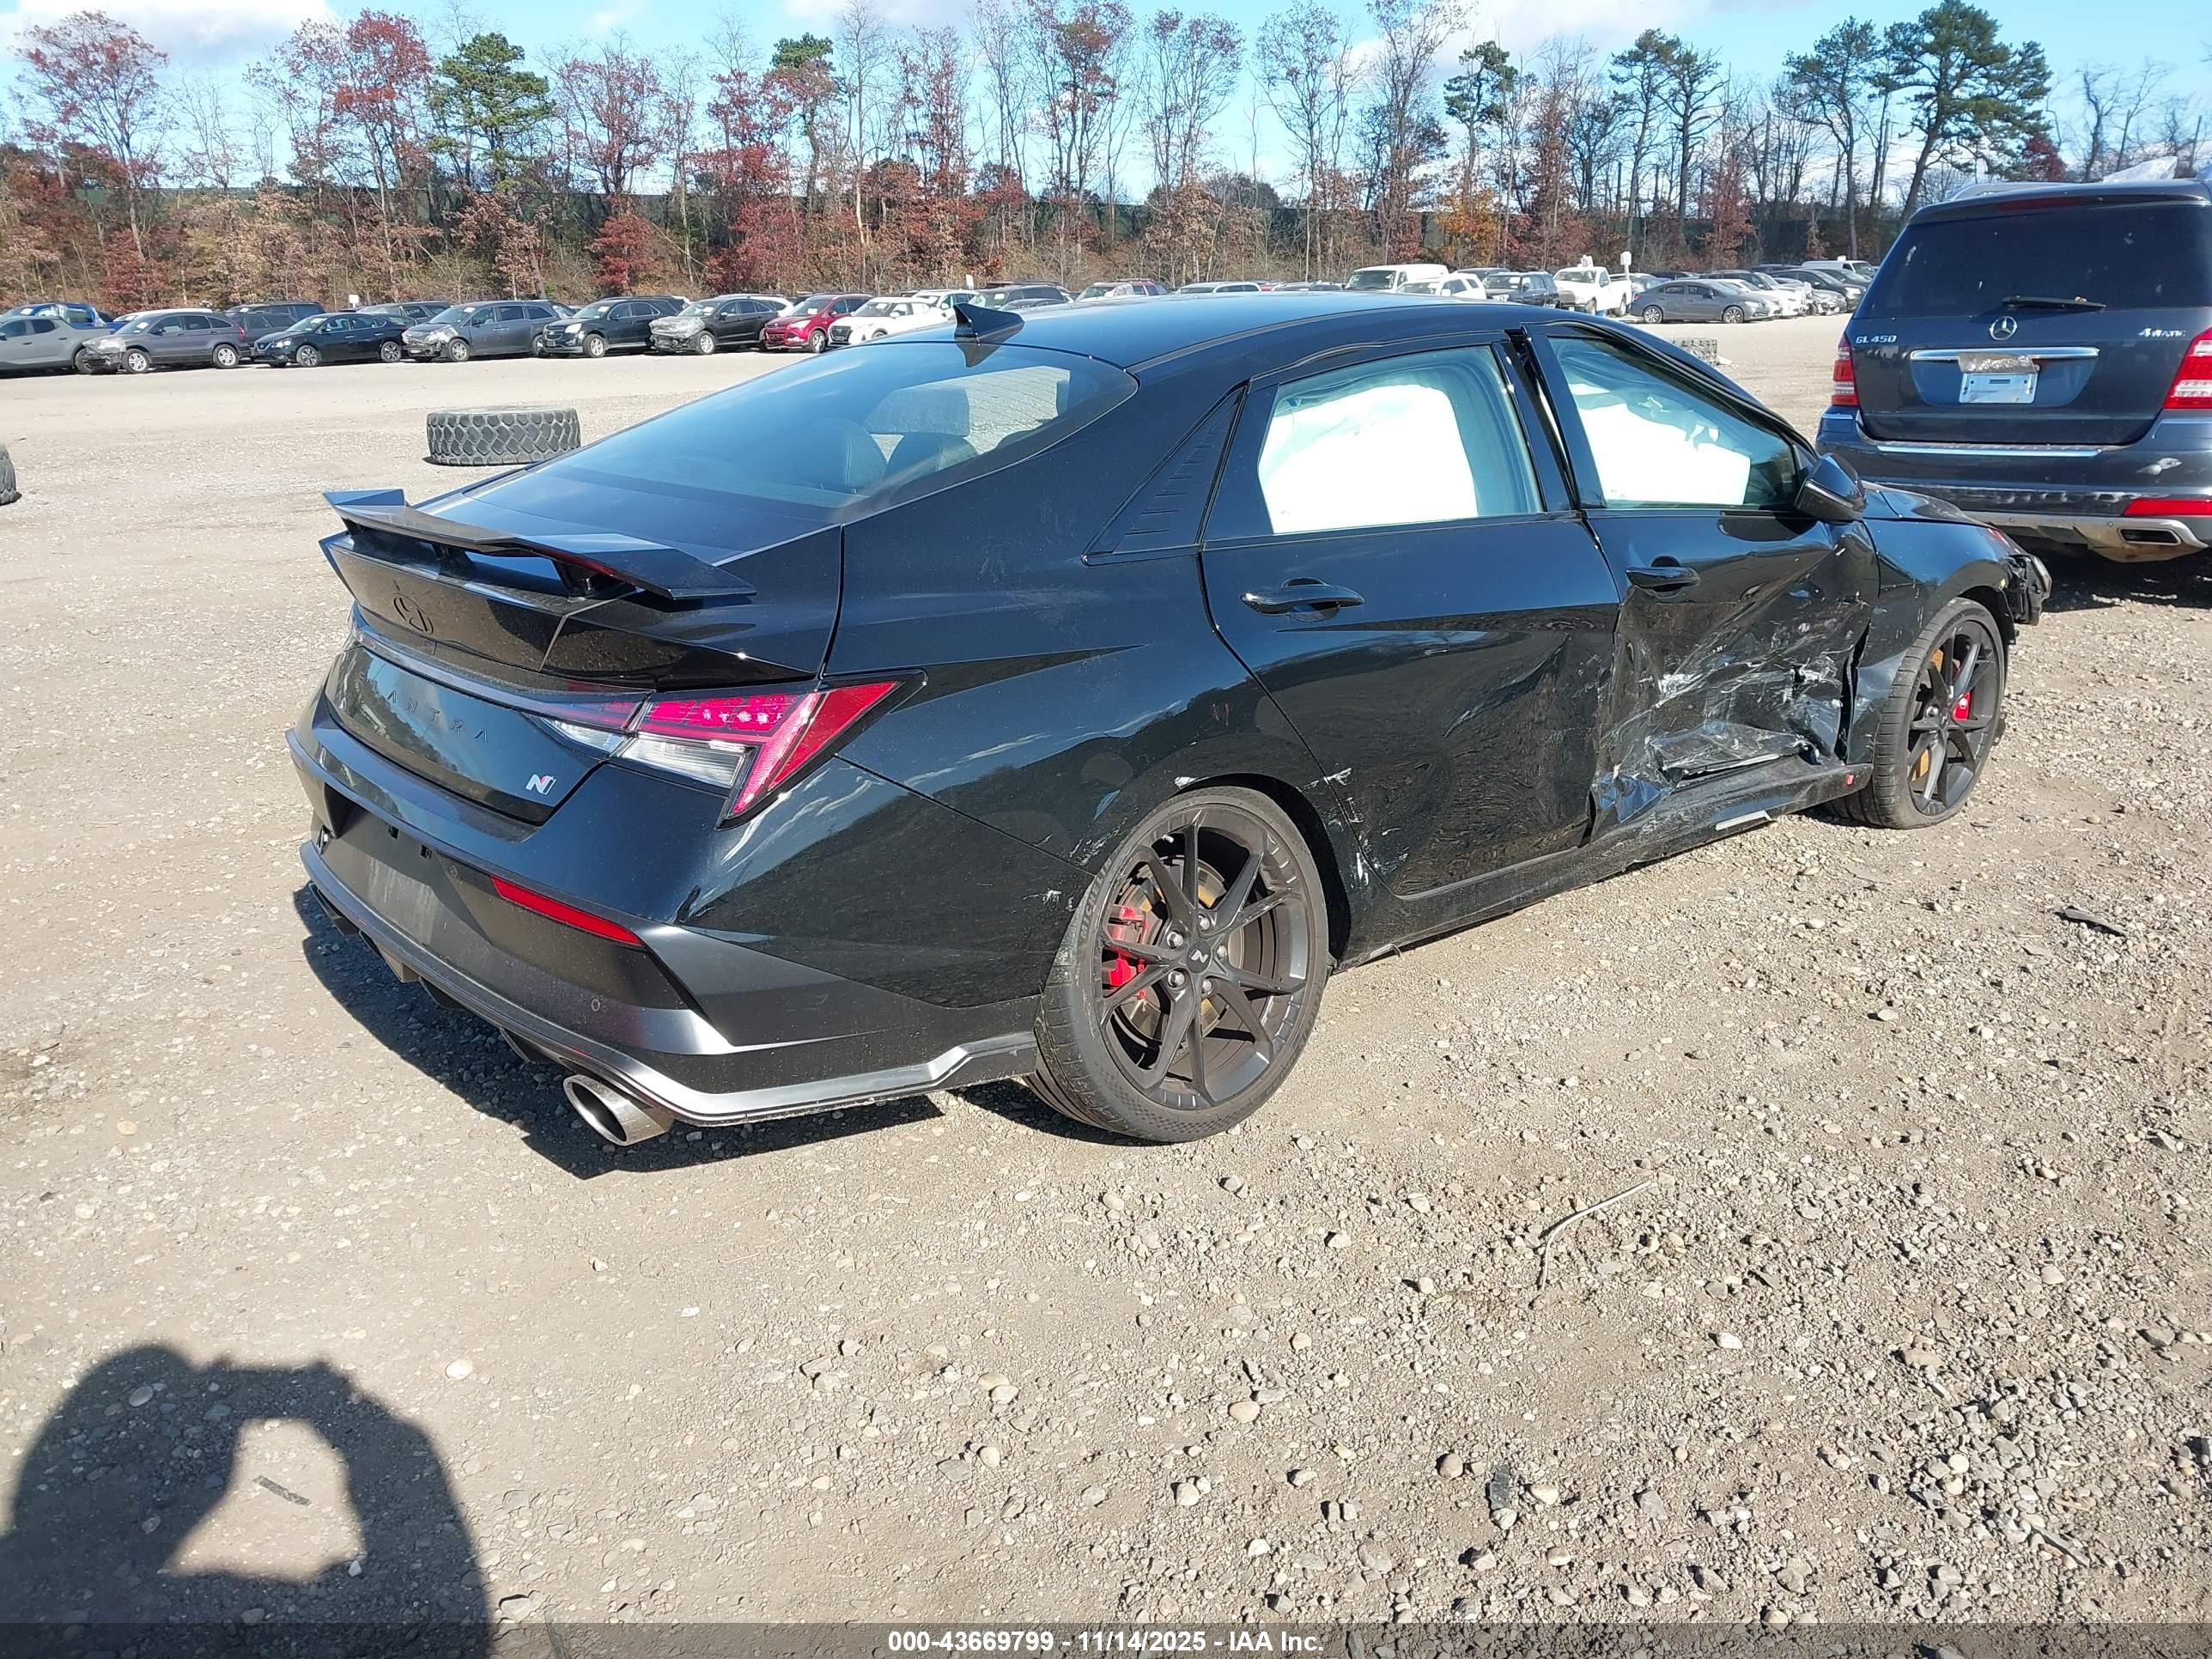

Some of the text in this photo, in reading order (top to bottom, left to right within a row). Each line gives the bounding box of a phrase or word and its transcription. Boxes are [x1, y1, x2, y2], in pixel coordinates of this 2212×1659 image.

[1871, 335, 1897, 343] 450
[525, 774, 557, 795] N
[1079, 857, 1114, 939] MICHELIN
